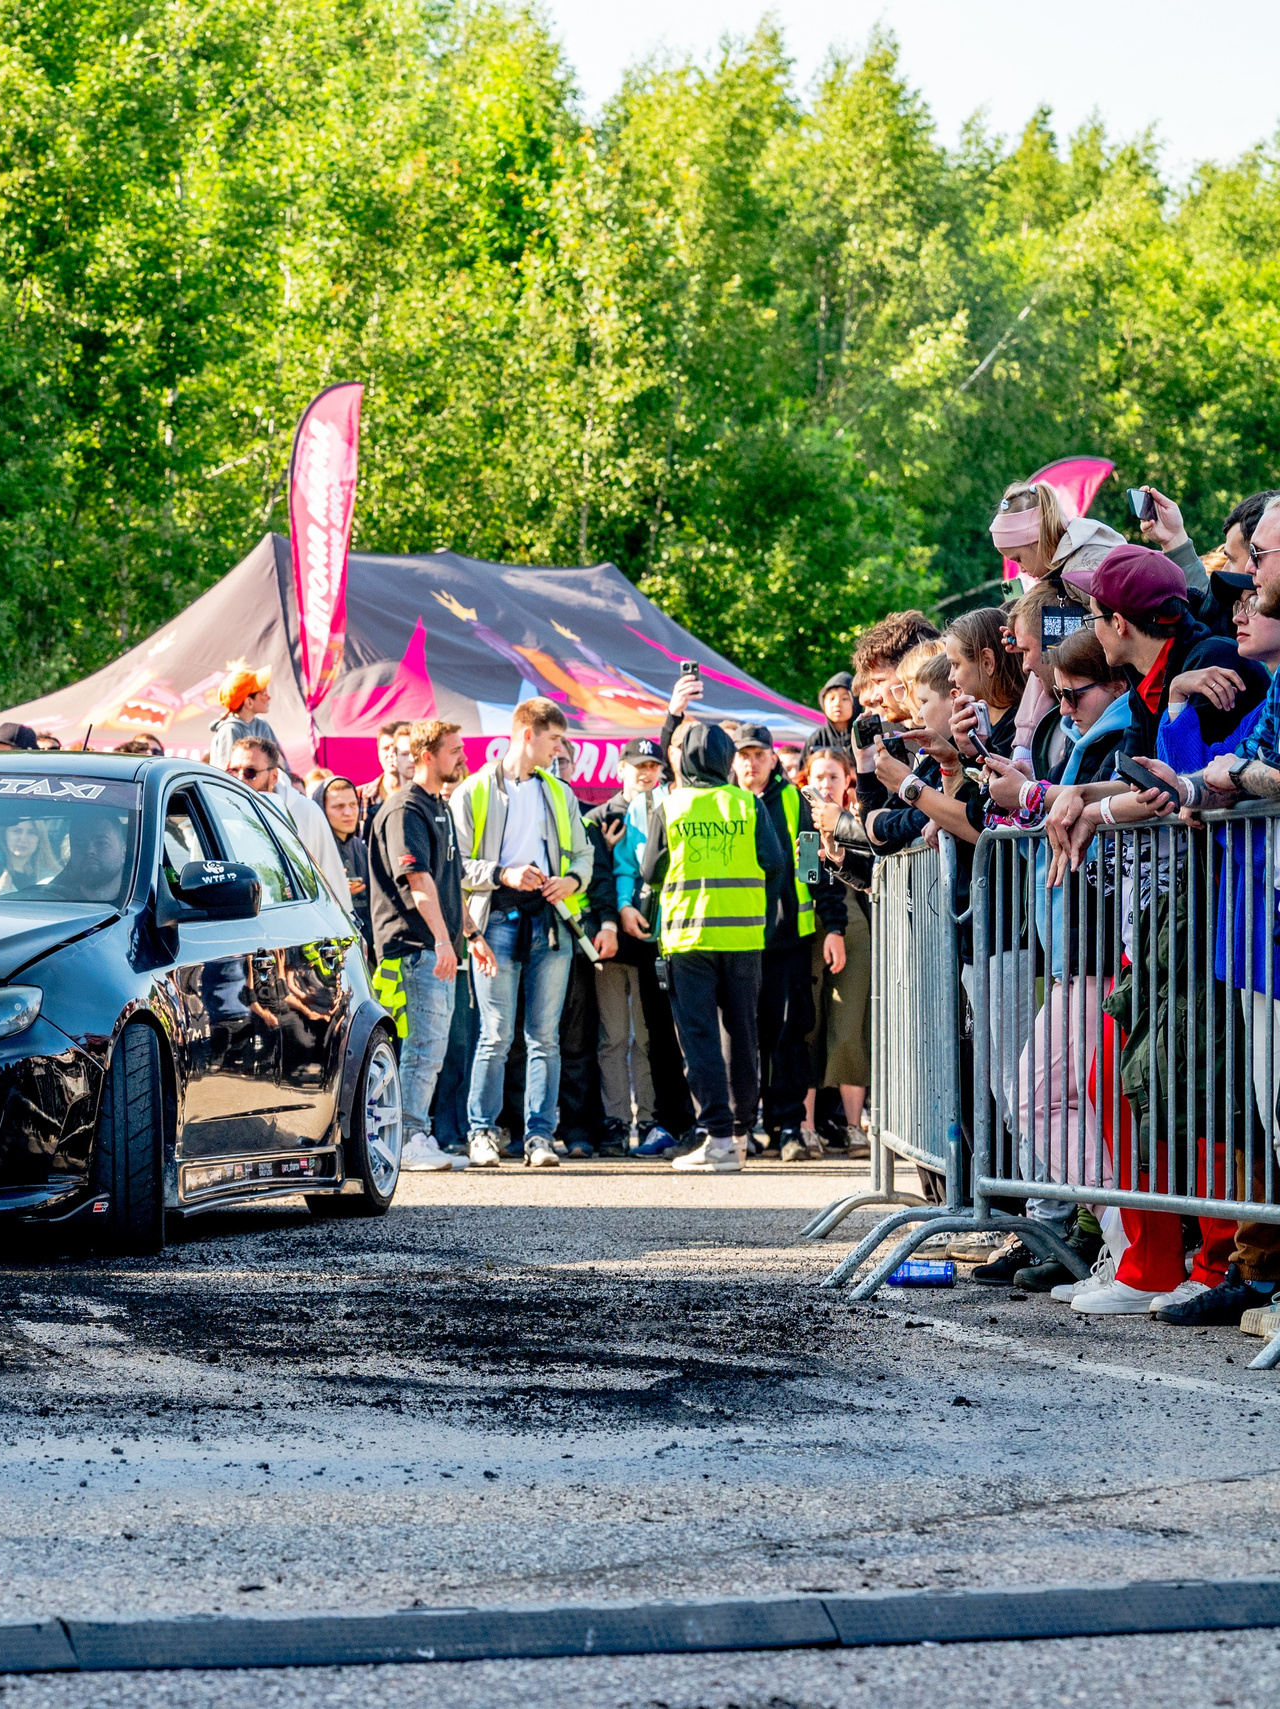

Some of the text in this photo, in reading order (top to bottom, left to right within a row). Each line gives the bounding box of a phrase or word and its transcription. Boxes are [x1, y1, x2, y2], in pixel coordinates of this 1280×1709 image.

[675, 819, 748, 837] WHYNOT
[687, 834, 735, 867] Staff
[201, 873, 225, 884] WTF
